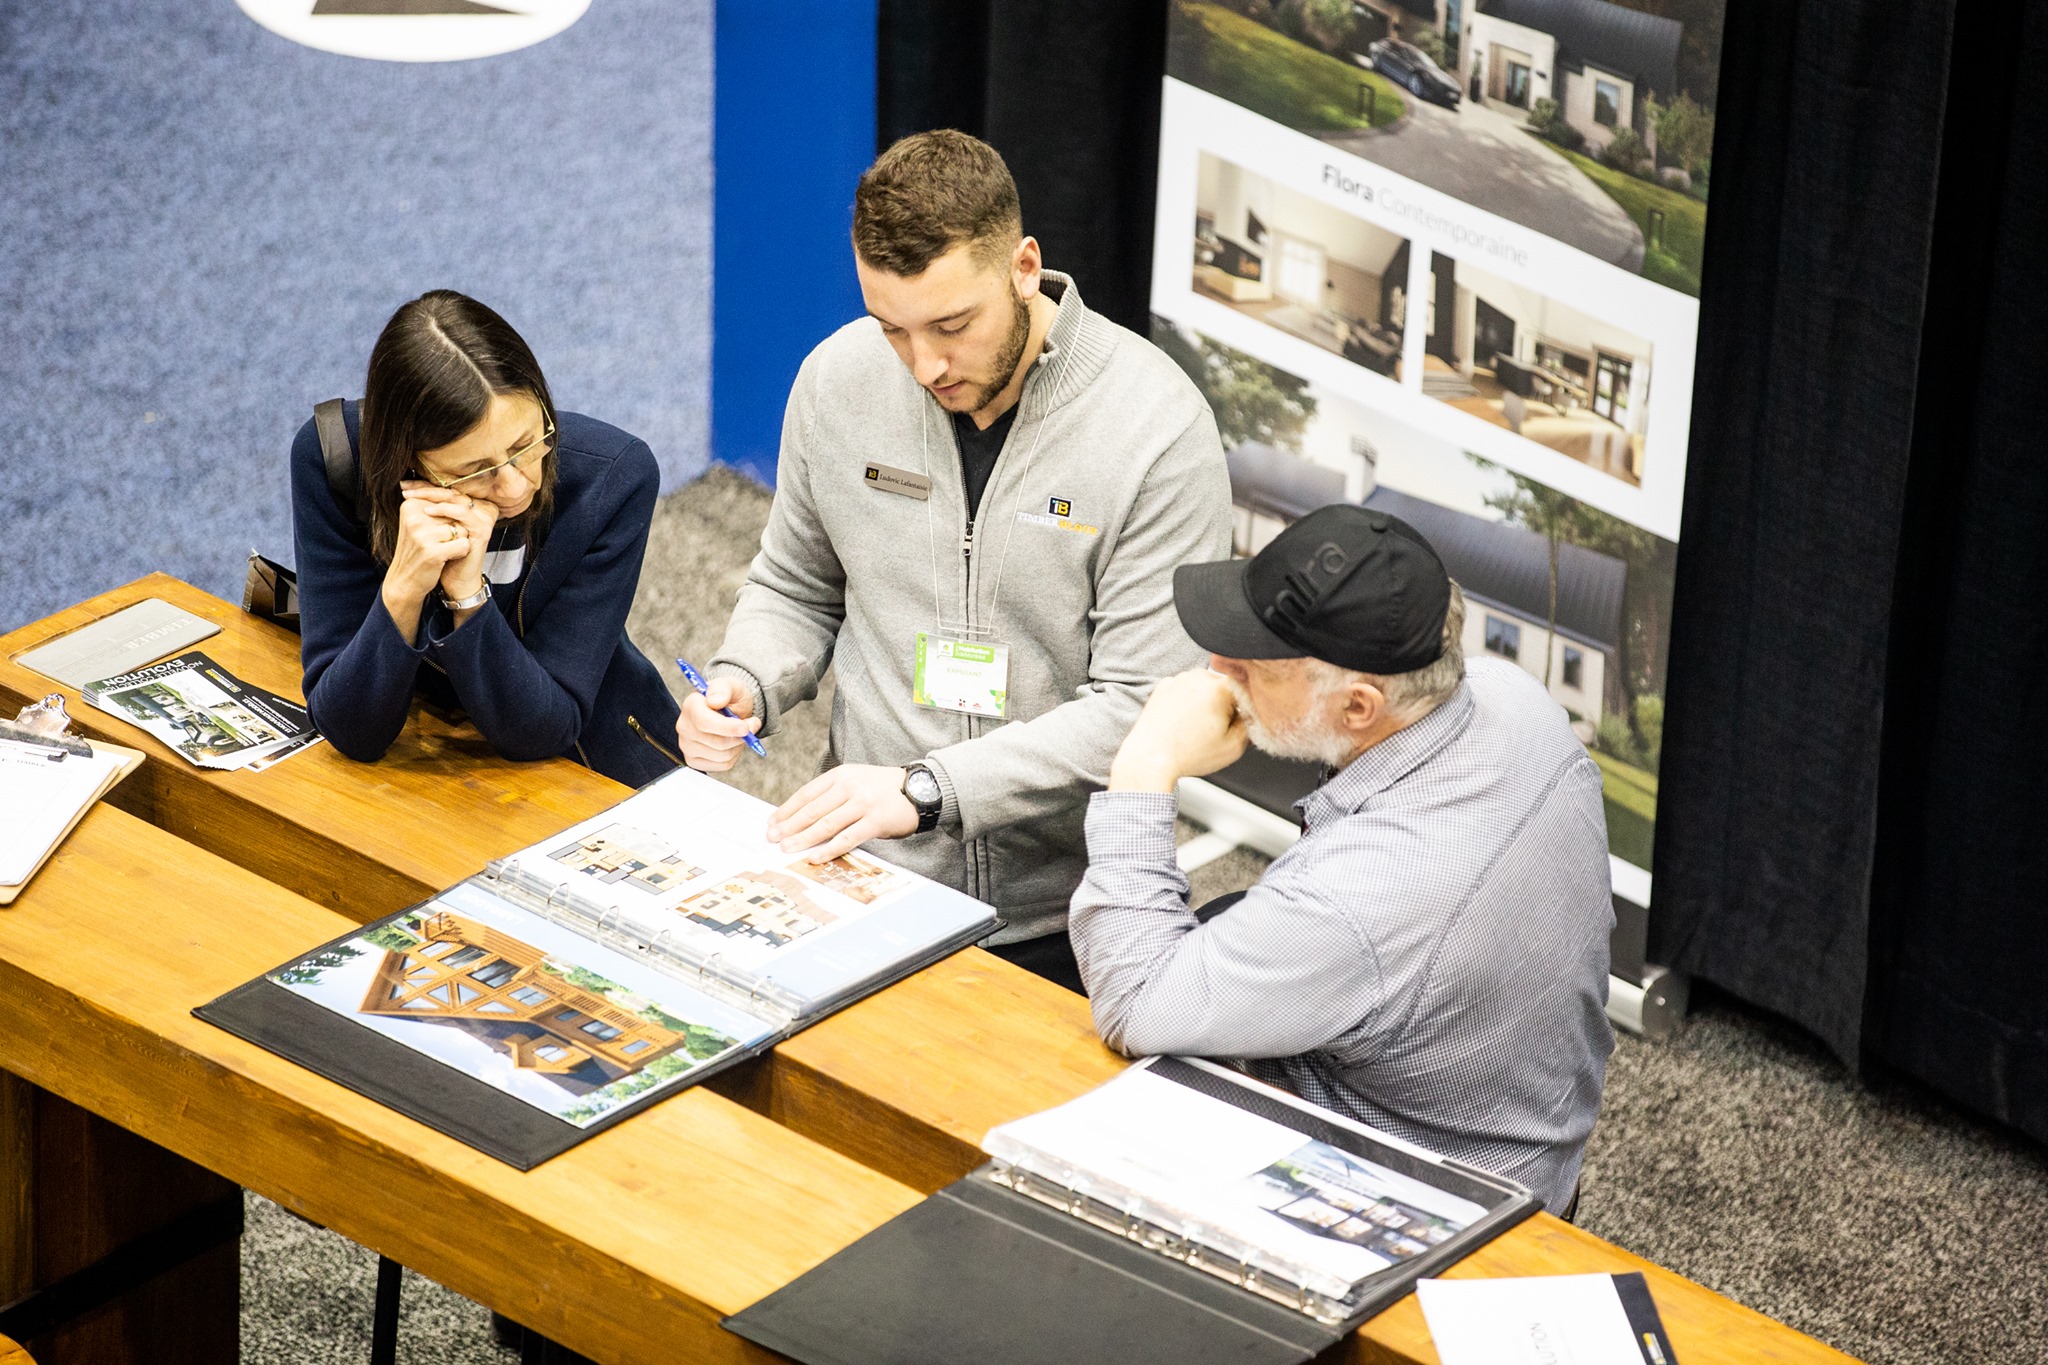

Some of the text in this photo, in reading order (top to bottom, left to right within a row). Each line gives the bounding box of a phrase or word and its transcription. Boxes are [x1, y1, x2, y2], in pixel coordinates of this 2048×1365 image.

[1322, 164, 1529, 267] Flora Contemporaine
[102, 659, 186, 687] EVOLUTION
[155, 660, 204, 681] NOUVELLE
